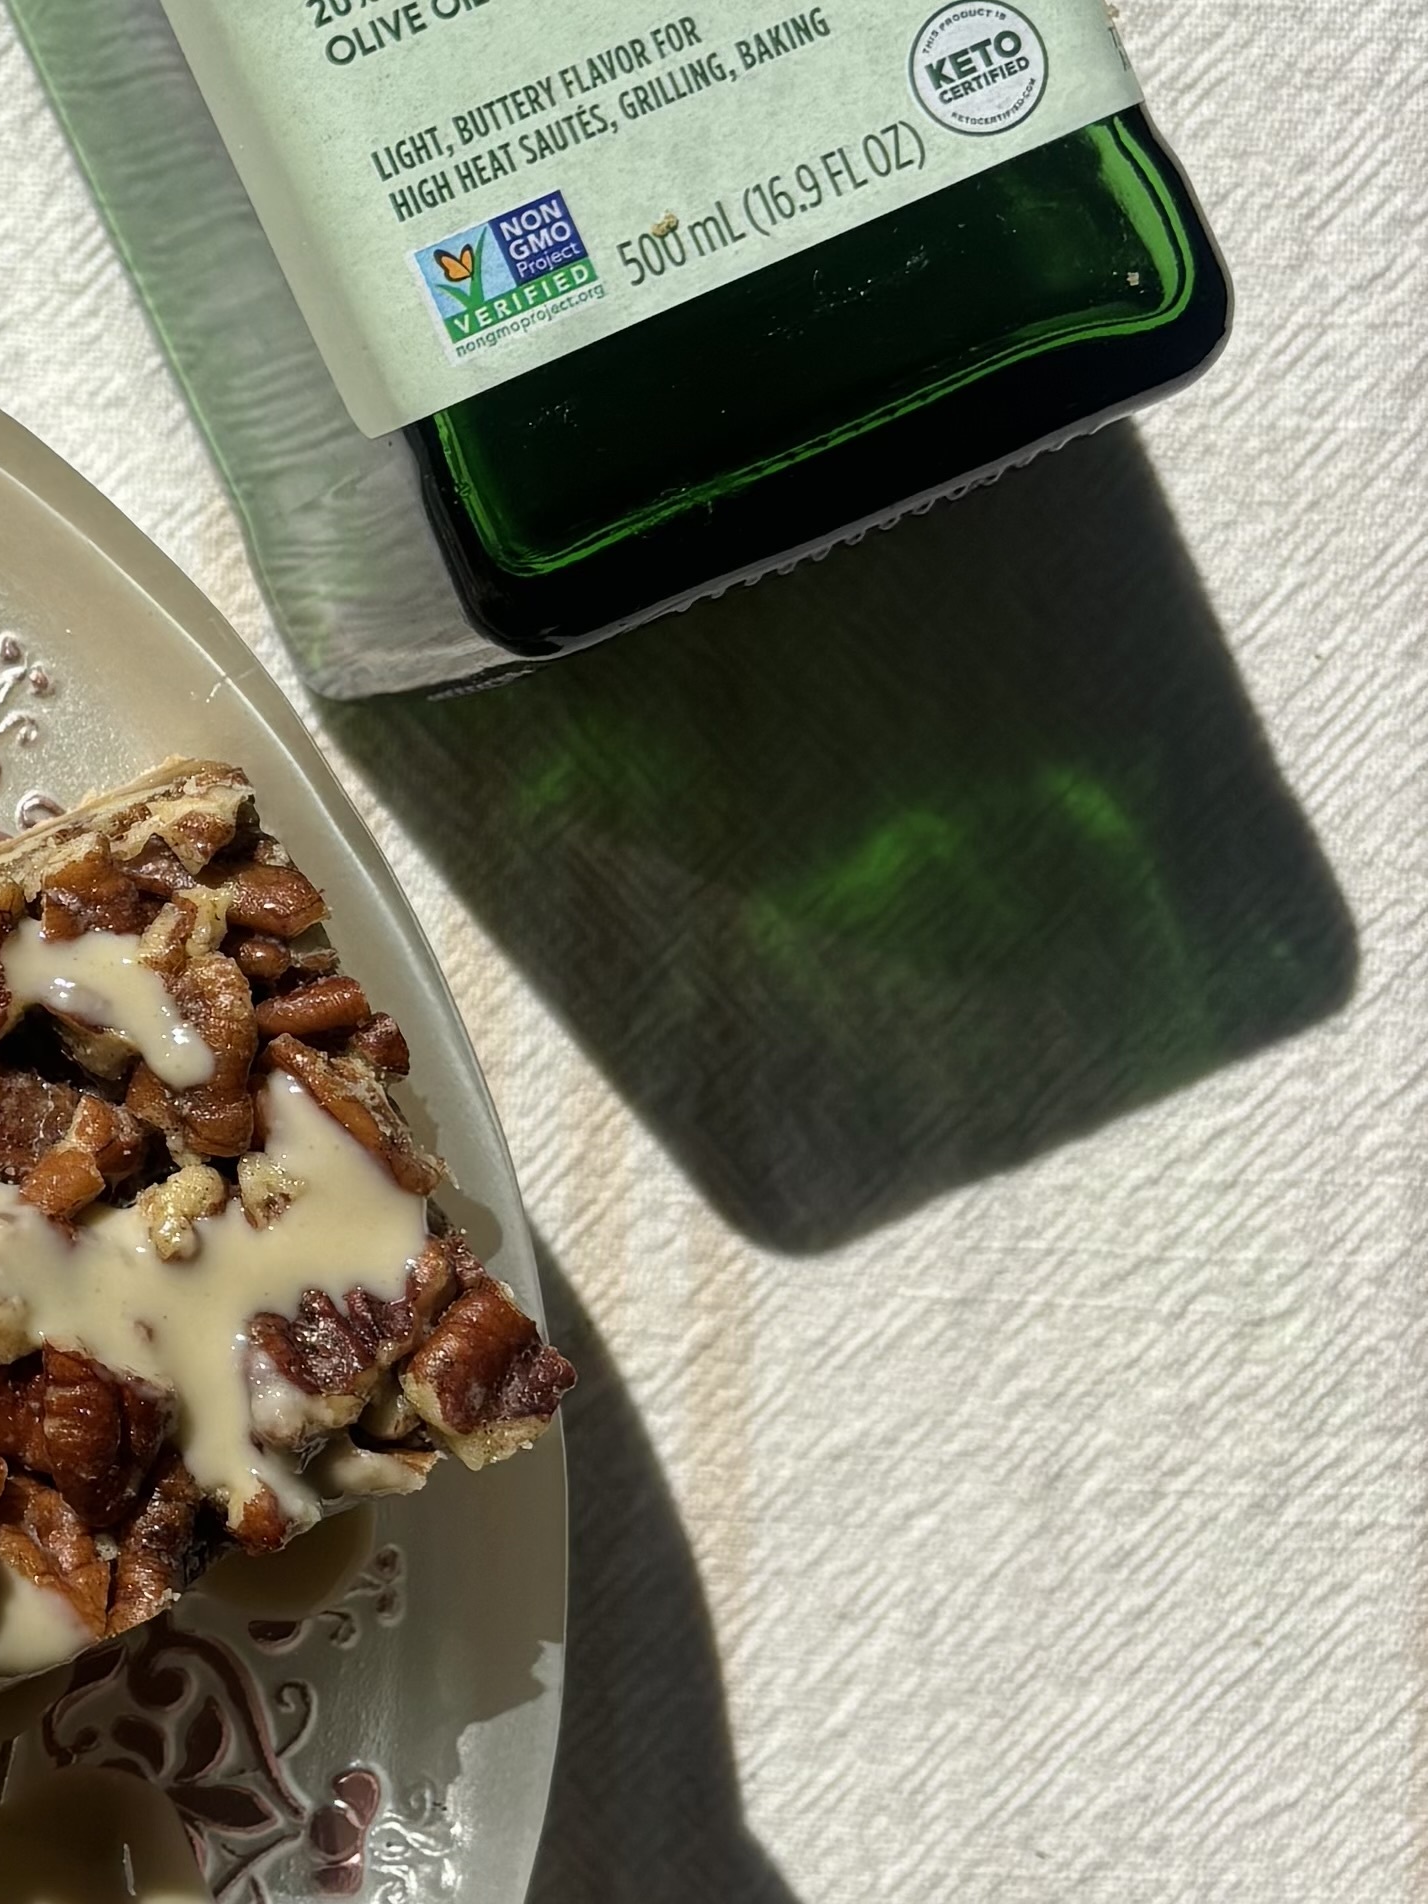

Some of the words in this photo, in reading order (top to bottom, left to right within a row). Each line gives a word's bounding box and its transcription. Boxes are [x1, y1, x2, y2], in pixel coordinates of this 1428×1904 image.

[325, 1, 427, 66] OLIVE
[922, 29, 939, 54] THIS
[939, 8, 993, 31] PRODUCT
[995, 11, 1007, 20] IS
[924, 30, 1022, 90] KETO
[370, 126, 454, 182] LIGHT,
[452, 76, 557, 145] BUTTERY
[558, 38, 652, 99] FLAVOR
[650, 16, 702, 59] FOR
[938, 56, 1030, 105] CERTIFIED
[388, 171, 456, 222] HIGH
[454, 142, 517, 193] HEAT
[518, 104, 618, 165] SAUTÉS,
[618, 52, 738, 120] GRILLING,
[735, 7, 831, 71] BAKING
[499, 199, 563, 241] NON
[616, 223, 686, 286] 500
[688, 201, 746, 257] mL
[743, 164, 823, 236] (16.9
[820, 147, 868, 197] FL
[861, 120, 926, 177] OZ)
[509, 221, 571, 260] GMO
[515, 242, 581, 277] Project
[453, 265, 589, 334] VERIFIED
[455, 284, 605, 357] nongmoproject.org
